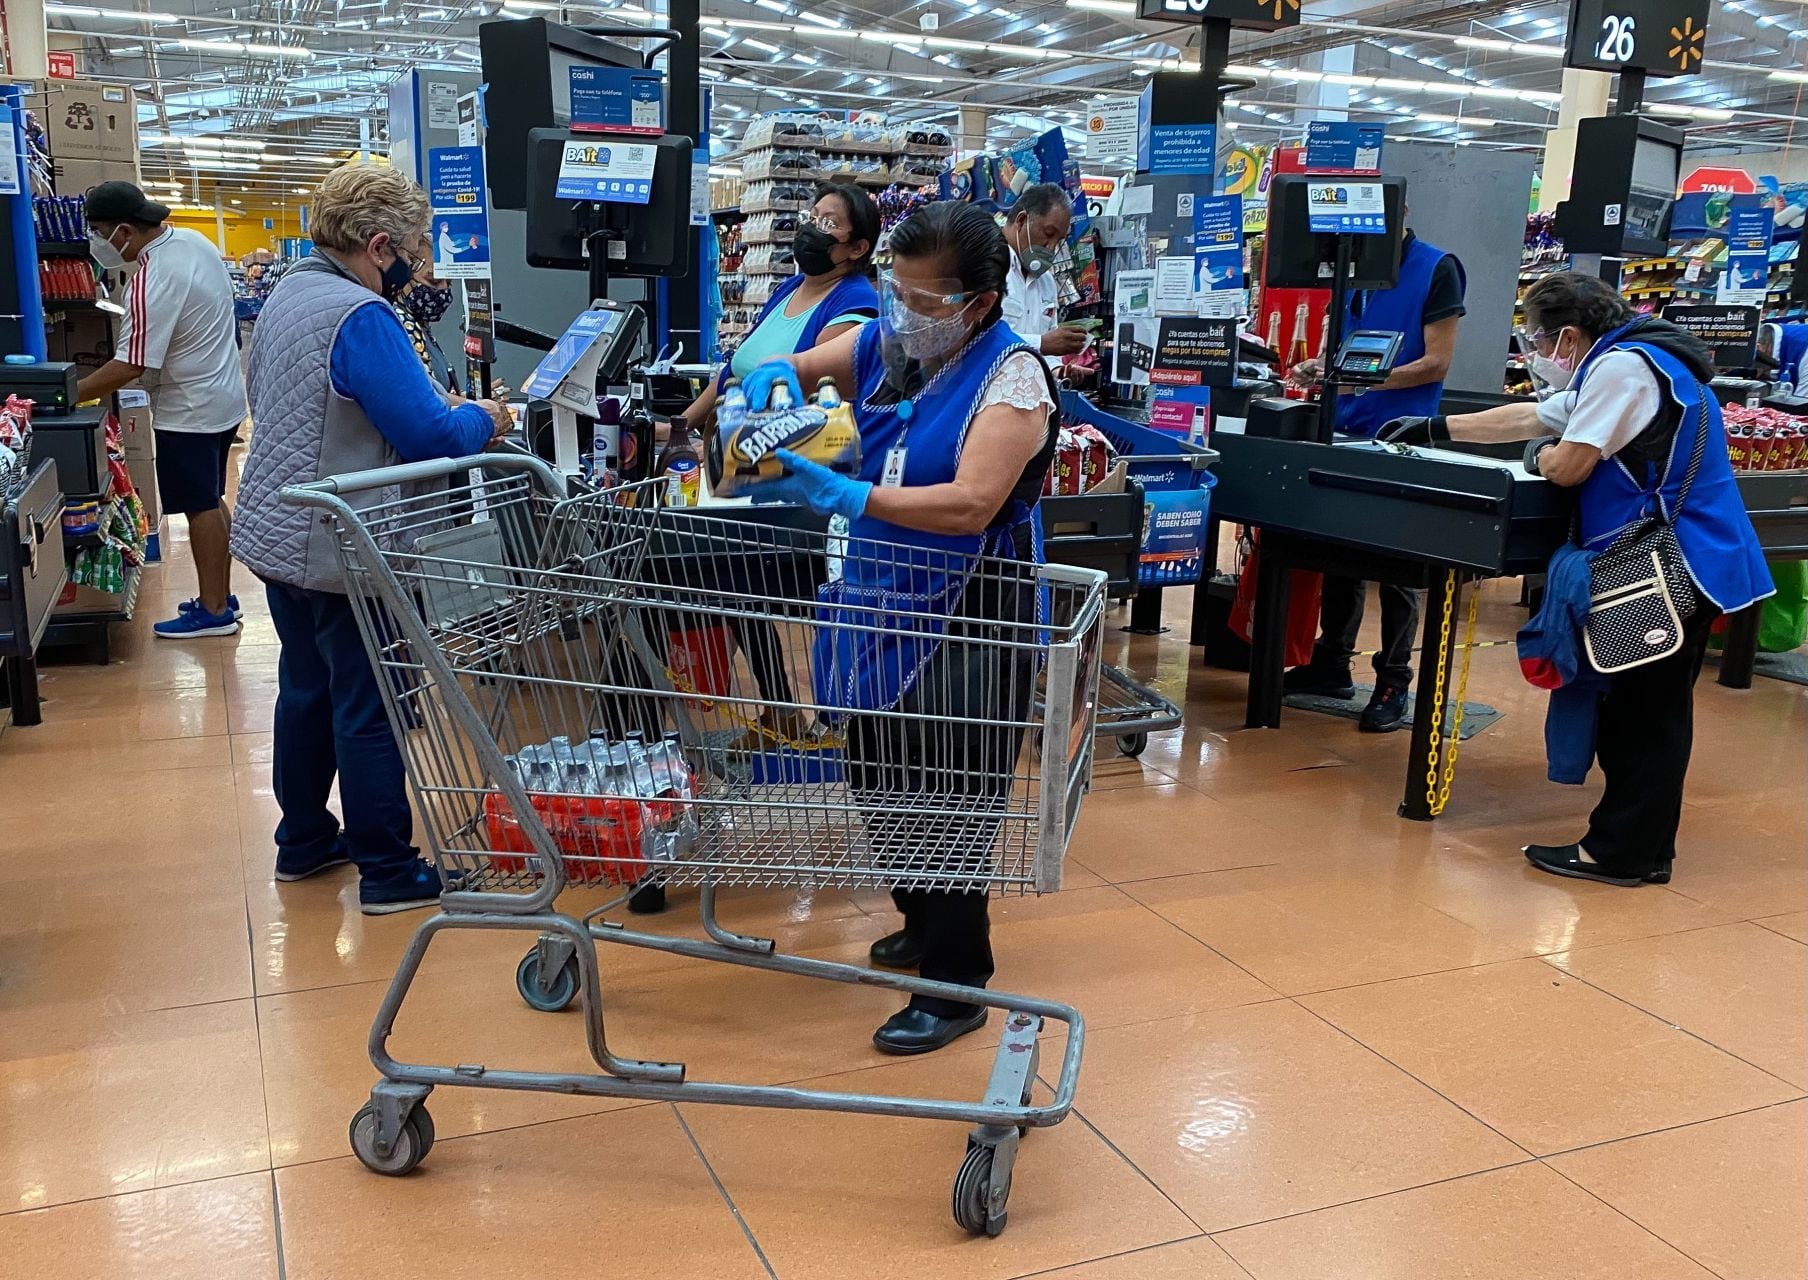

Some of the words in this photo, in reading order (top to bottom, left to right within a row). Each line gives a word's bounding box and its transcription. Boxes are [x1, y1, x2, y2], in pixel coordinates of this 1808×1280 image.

[1600, 15, 1635, 61] 26
[572, 71, 594, 79] cashi
[1184, 129, 1211, 137] cigarros
[1163, 138, 1196, 147] prohibida
[559, 187, 584, 195] Walmart
[1162, 347, 1179, 355] megas
[1192, 347, 1201, 355] tus
[1202, 349, 1230, 357] compras?
[1135, 474, 1165, 483] Walmart
[1157, 512, 1181, 520] SABEN
[1182, 510, 1202, 518] COMO
[1156, 520, 1179, 528] DEBEN
[1180, 518, 1201, 527] SABER
